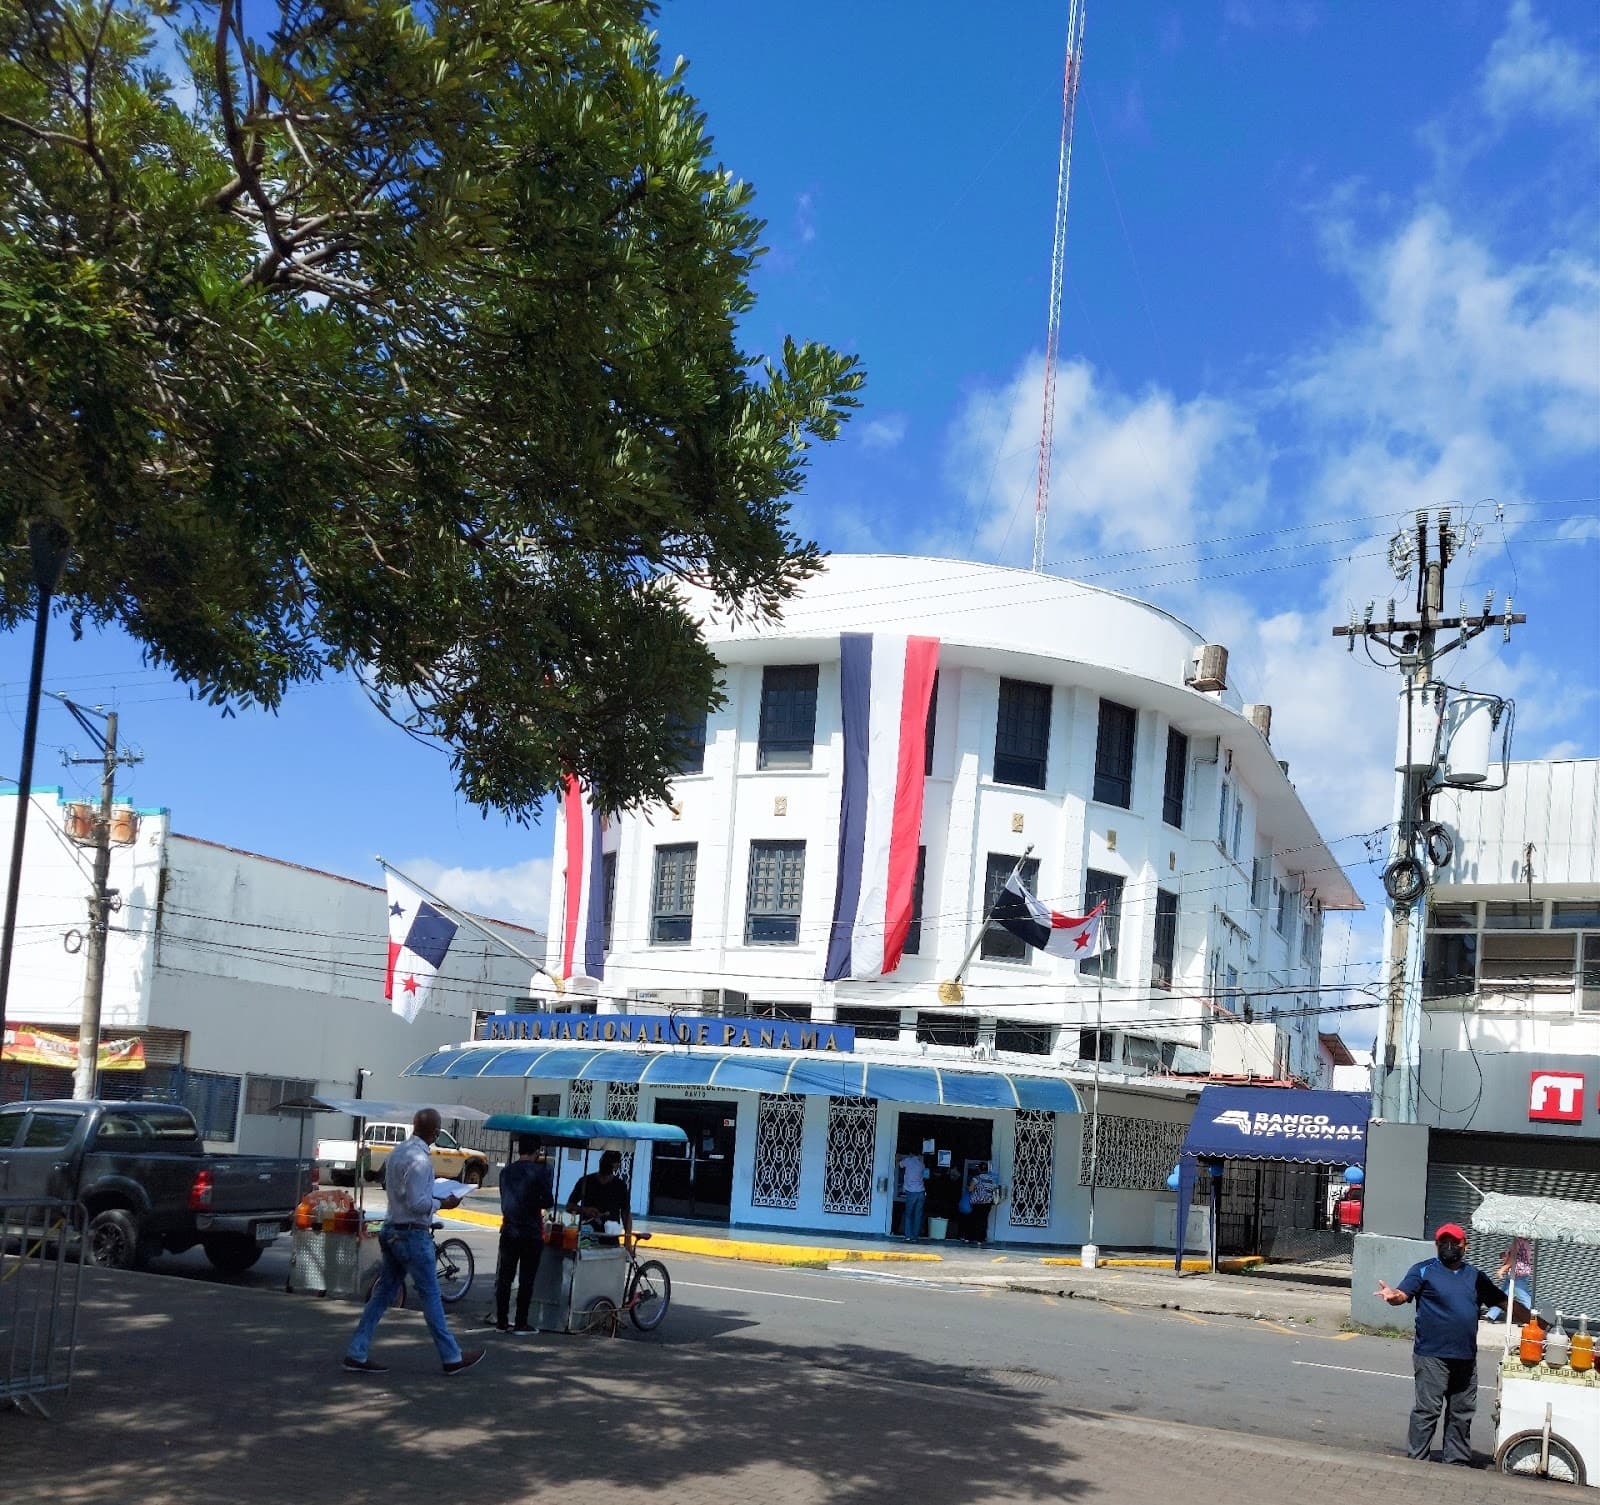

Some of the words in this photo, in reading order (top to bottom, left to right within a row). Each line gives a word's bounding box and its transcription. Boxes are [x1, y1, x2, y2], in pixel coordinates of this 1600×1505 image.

[491, 1020, 541, 1040] BANCO
[549, 1020, 664, 1043] NACIONAL
[679, 1022, 709, 1045] DE
[723, 1024, 839, 1051] PANAMA
[1254, 1112, 1329, 1124] BANCO
[1253, 1122, 1364, 1135] NACIONAL
[1285, 1132, 1362, 1141] PANAMA
